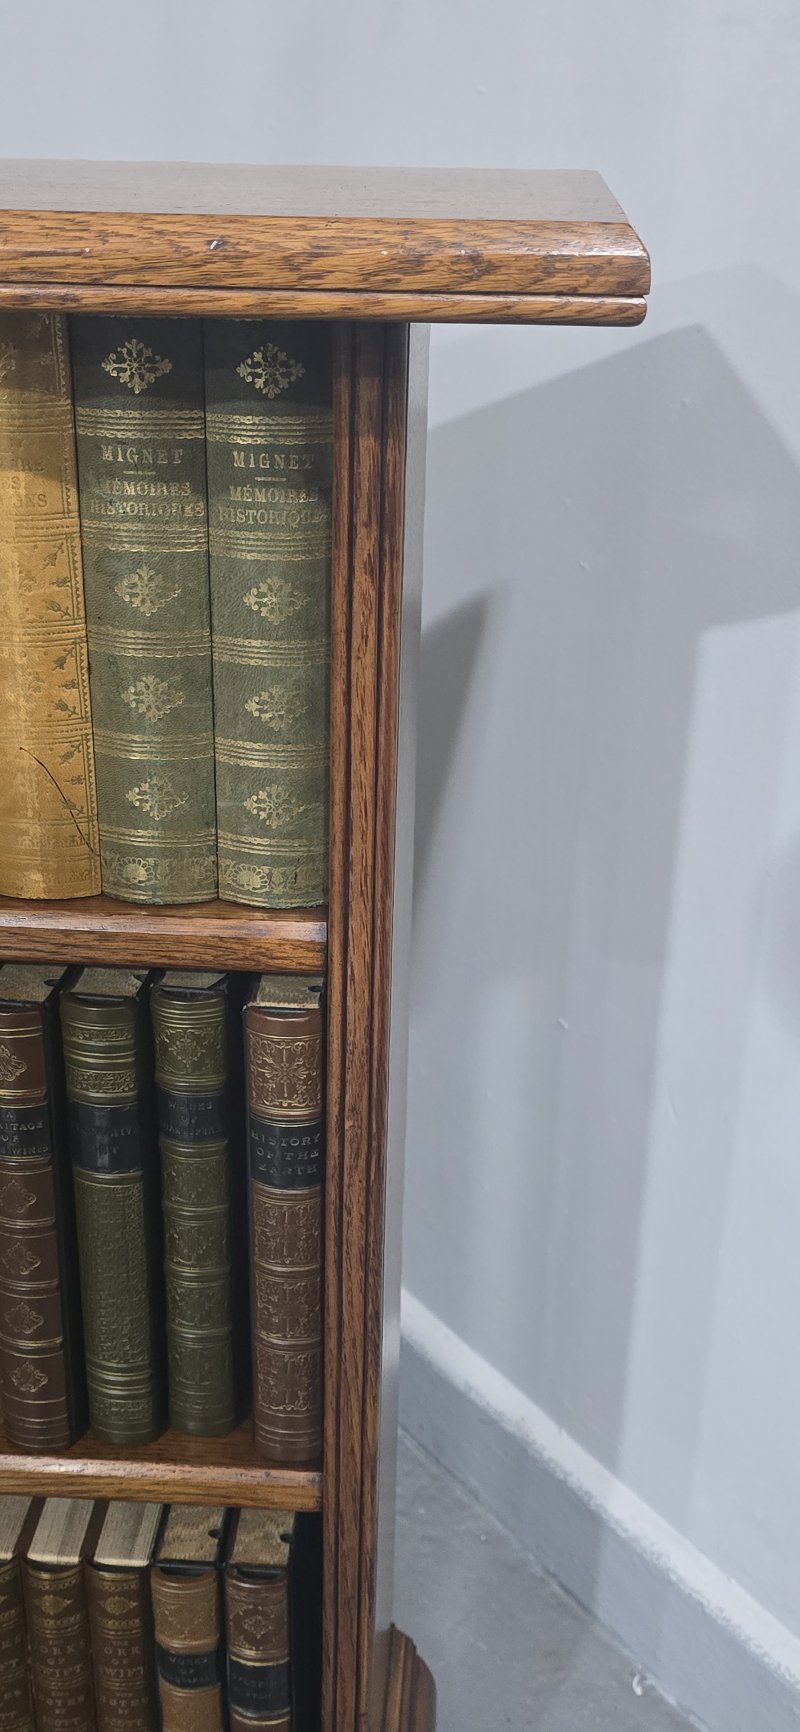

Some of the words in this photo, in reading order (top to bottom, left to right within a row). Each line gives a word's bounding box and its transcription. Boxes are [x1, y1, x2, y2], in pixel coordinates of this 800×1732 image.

[101, 444, 183, 464] MIGNET
[232, 451, 315, 470] MIGNET
[251, 1129, 320, 1147] HISTORY
[256, 1147, 274, 1159] OF
[283, 1149, 319, 1161] THE
[258, 1163, 318, 1176] EARTH
